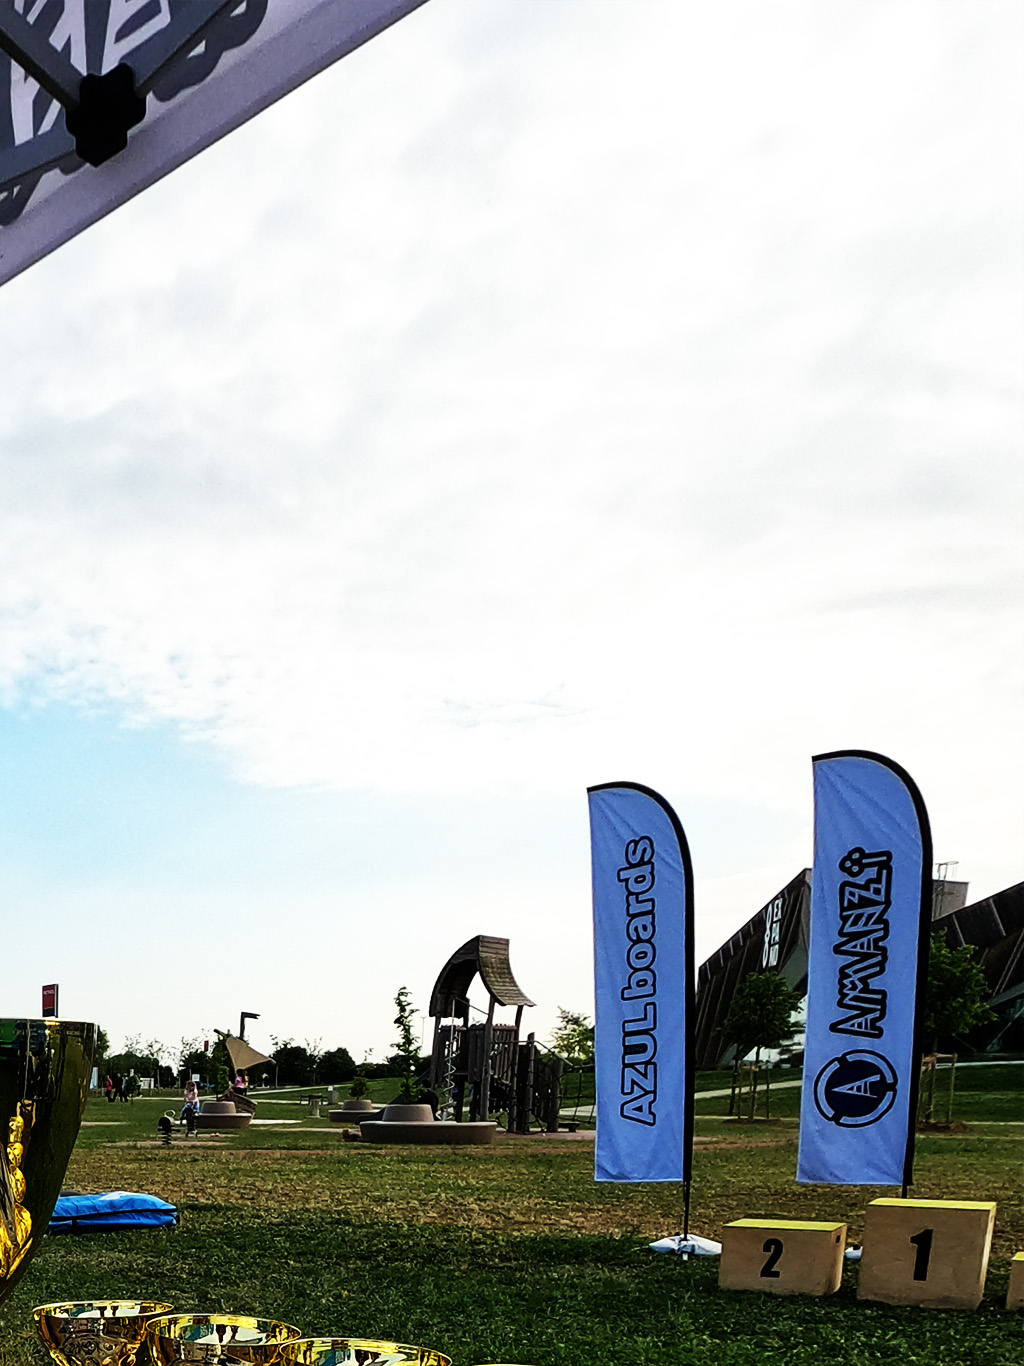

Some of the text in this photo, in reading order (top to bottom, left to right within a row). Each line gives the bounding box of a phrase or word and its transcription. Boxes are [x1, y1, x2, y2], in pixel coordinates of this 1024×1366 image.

[618, 836, 657, 1126] AZUL boards
[760, 1238, 784, 1278] 2
[910, 1229, 934, 1281] 1
